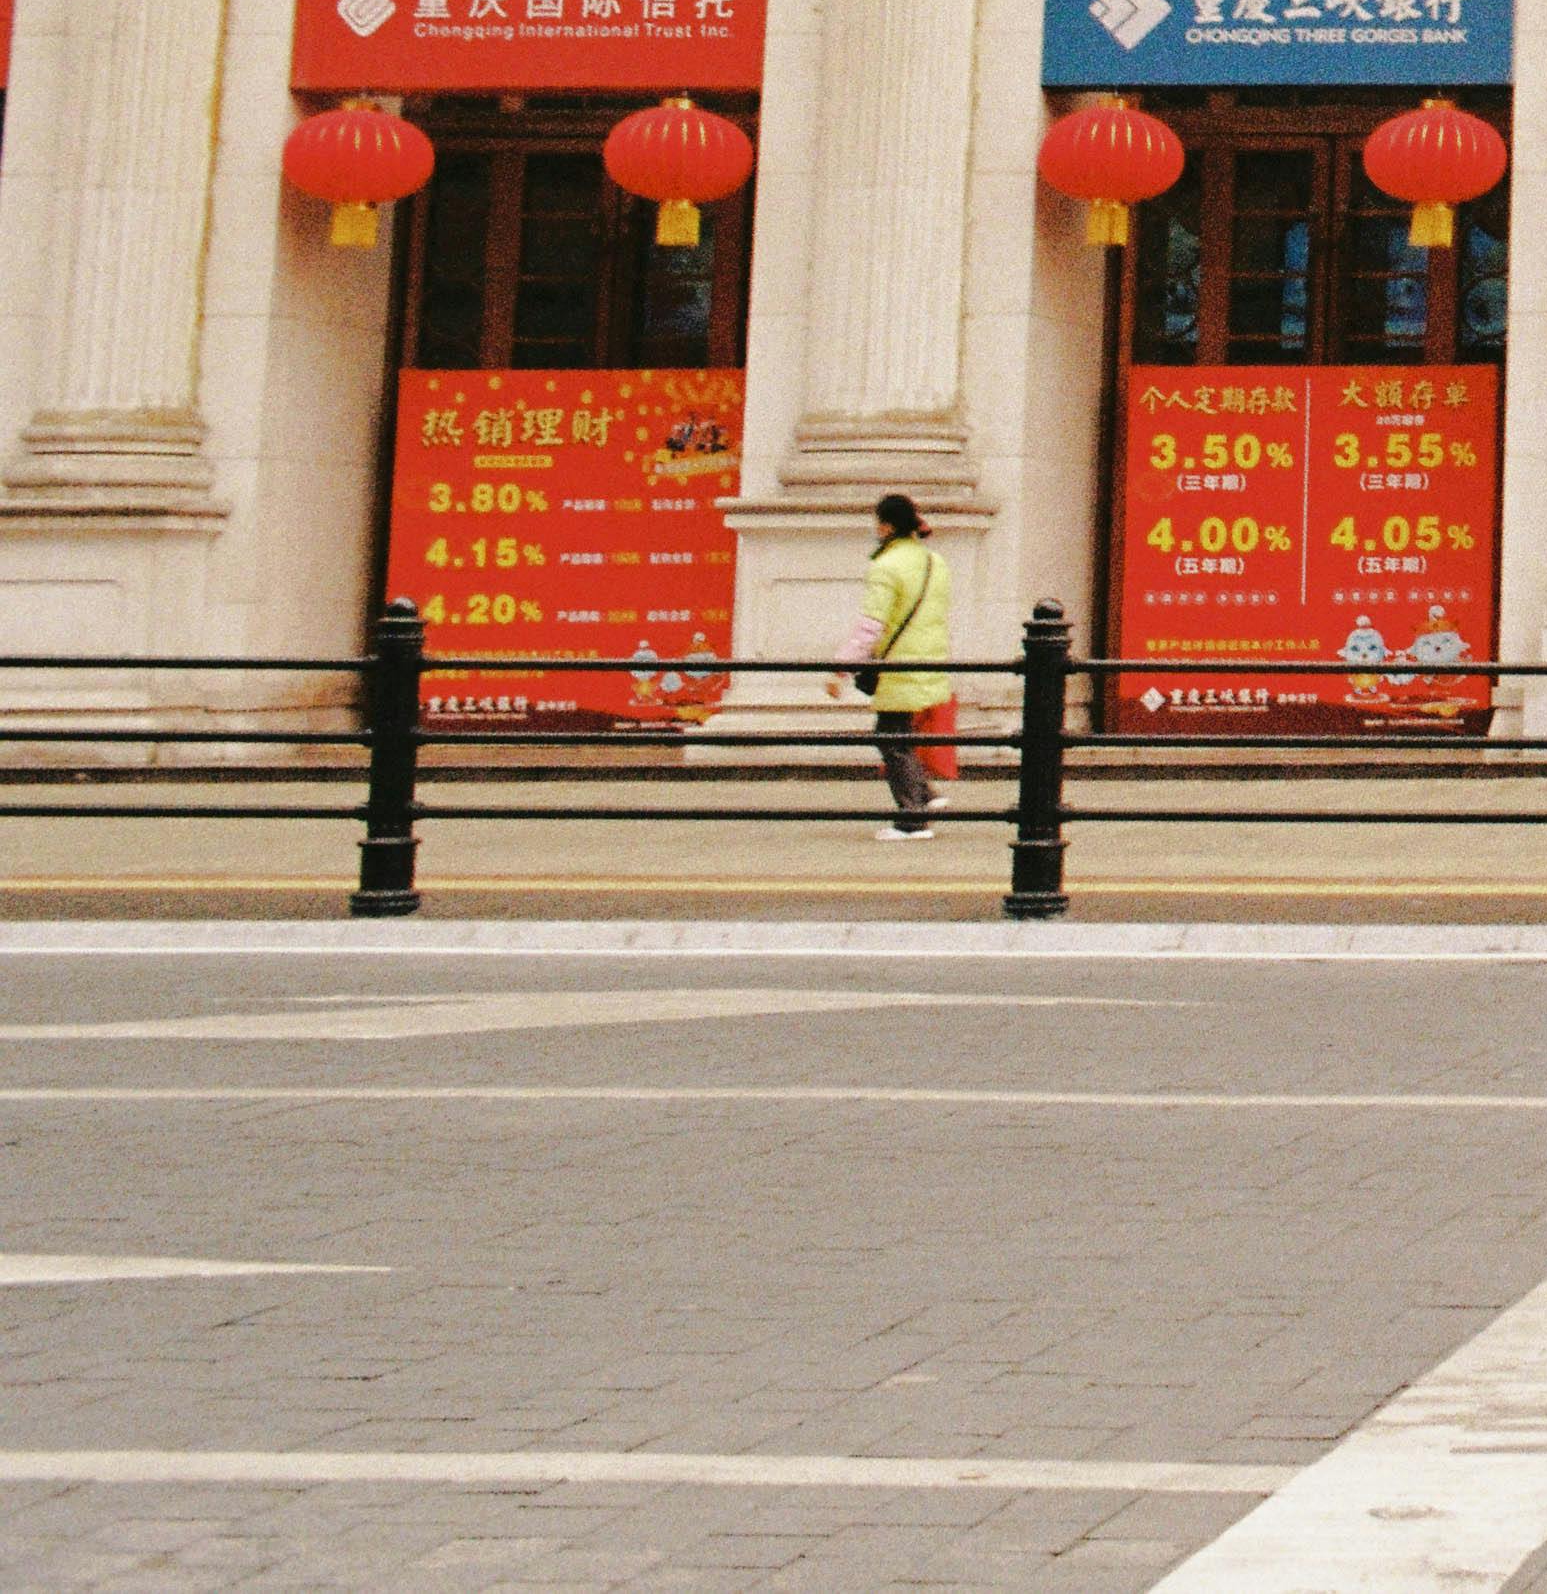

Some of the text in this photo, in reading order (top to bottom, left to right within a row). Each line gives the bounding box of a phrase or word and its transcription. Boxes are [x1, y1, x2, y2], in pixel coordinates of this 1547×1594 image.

[414, 22, 734, 40] Chongqing International Trust Inc.
[1185, 28, 1467, 46] CHONGQING THREE GORGES BANK
[1140, 385, 1297, 415] 个人定期存款
[1151, 435, 1293, 469] 3.50%
[1334, 434, 1476, 468] 3.55%
[428, 483, 548, 513] 3.80%
[1147, 517, 1291, 552] 4.00%
[1331, 516, 1474, 551] 4.05%
[425, 538, 546, 568] 4.15%
[422, 594, 543, 624] 4.20%
